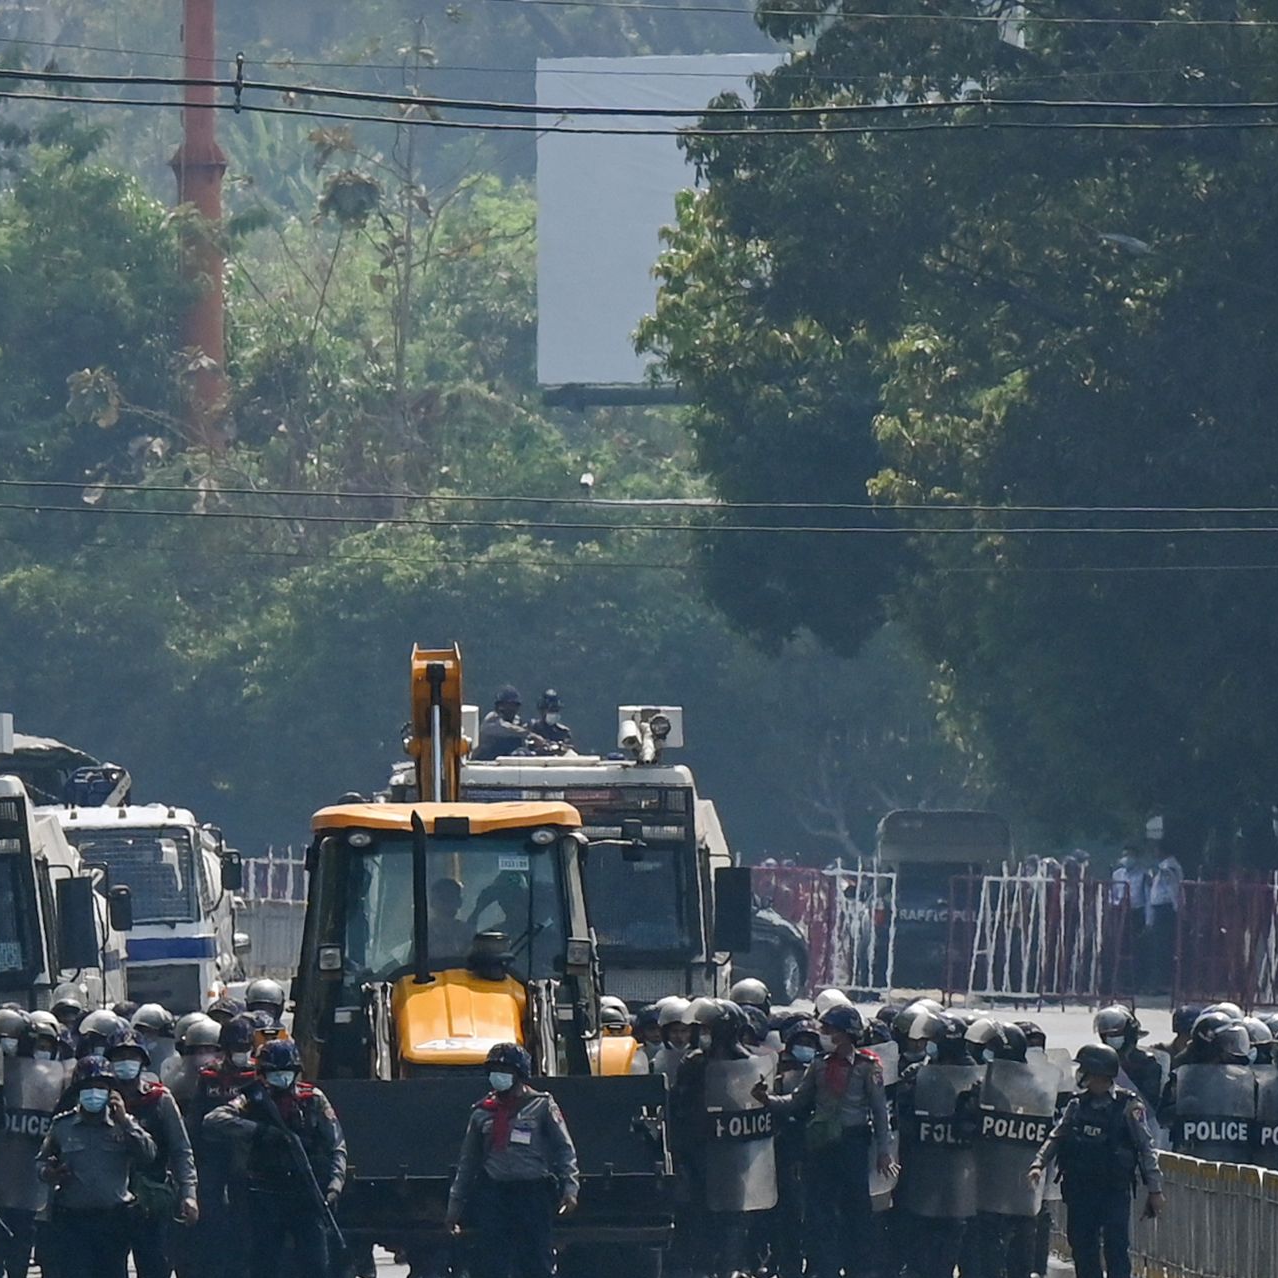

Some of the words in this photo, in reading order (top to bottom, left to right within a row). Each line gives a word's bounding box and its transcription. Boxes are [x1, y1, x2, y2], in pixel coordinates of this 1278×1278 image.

[898, 908, 948, 922] RAFFIC
[5, 1112, 50, 1136] LICE
[982, 1116, 1047, 1142] POLICE
[1183, 1121, 1248, 1141] POLICE
